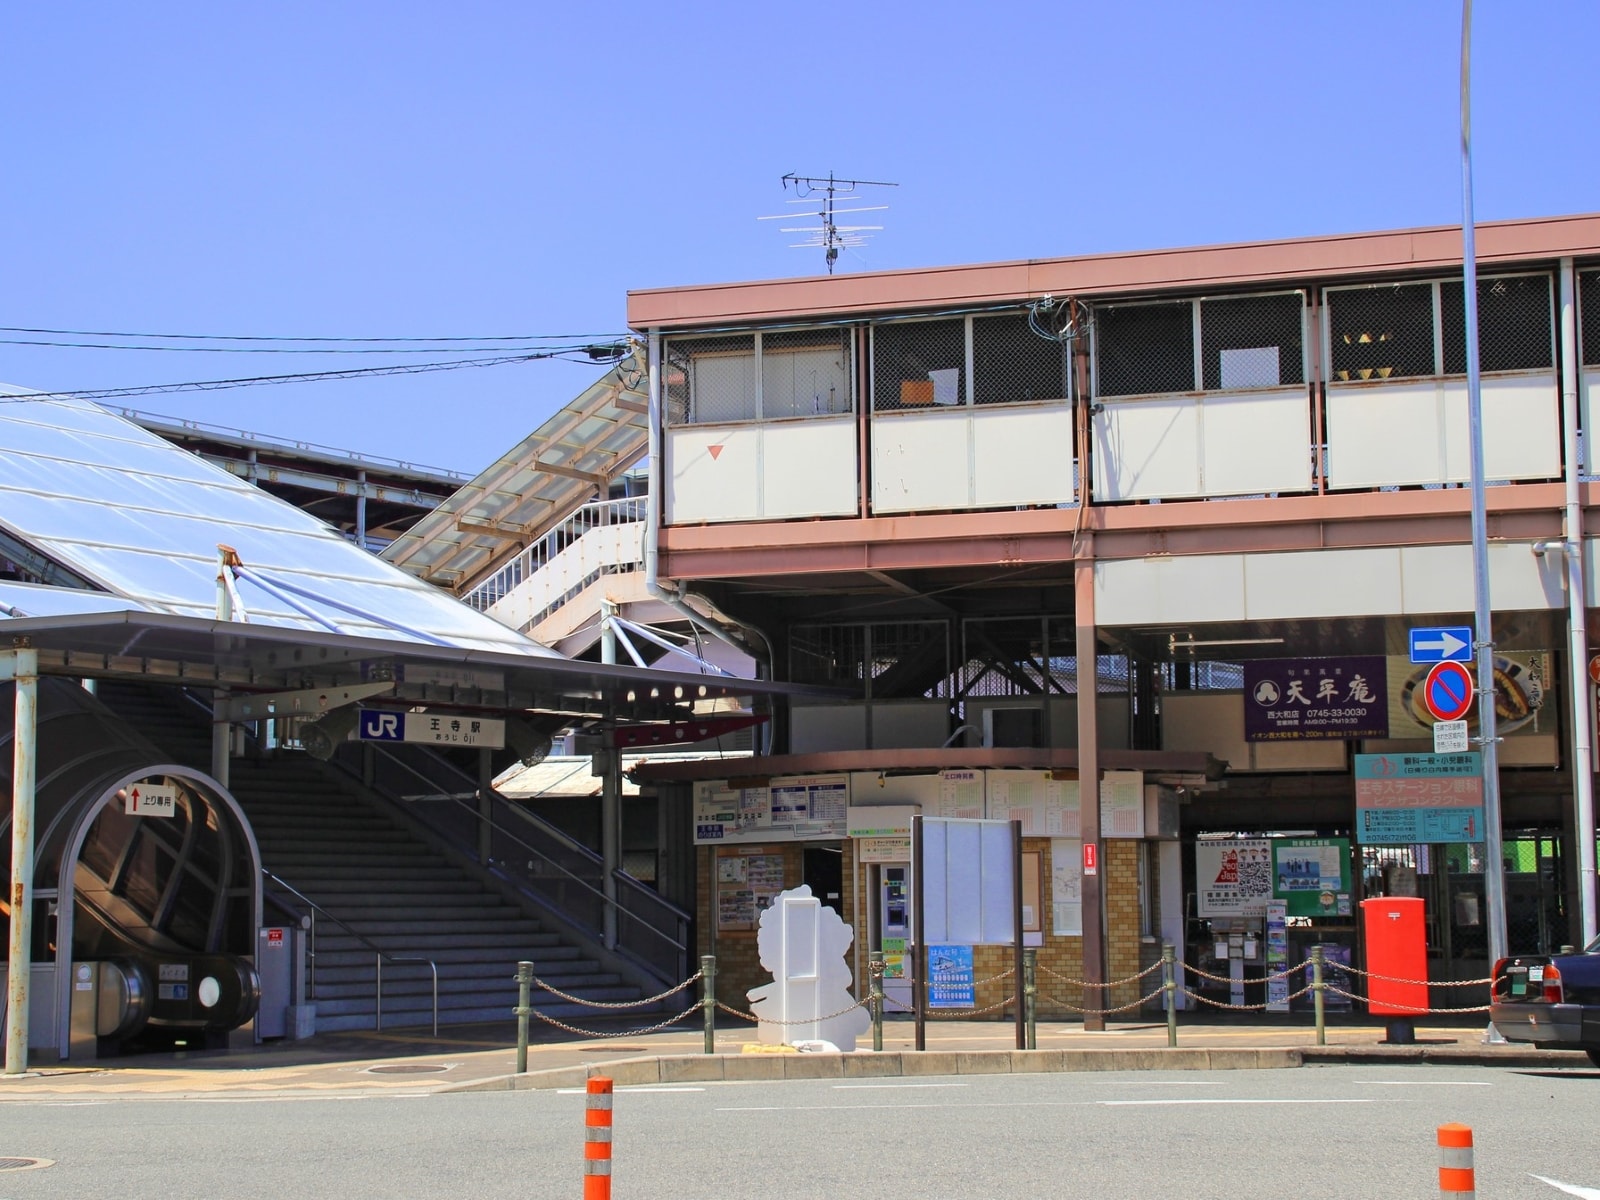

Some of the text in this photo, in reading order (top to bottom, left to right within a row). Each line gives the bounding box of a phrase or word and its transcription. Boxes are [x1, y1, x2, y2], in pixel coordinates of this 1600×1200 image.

[1286, 674, 1377, 706] 天平庵
[1267, 708, 1367, 720] 西大和店 0745-33-0030
[367, 714, 398, 738] JR
[430, 718, 481, 734] 王寺駅
[1360, 779, 1478, 796] 王寺ステーション眼科
[143, 795, 172, 807] 上り専用
